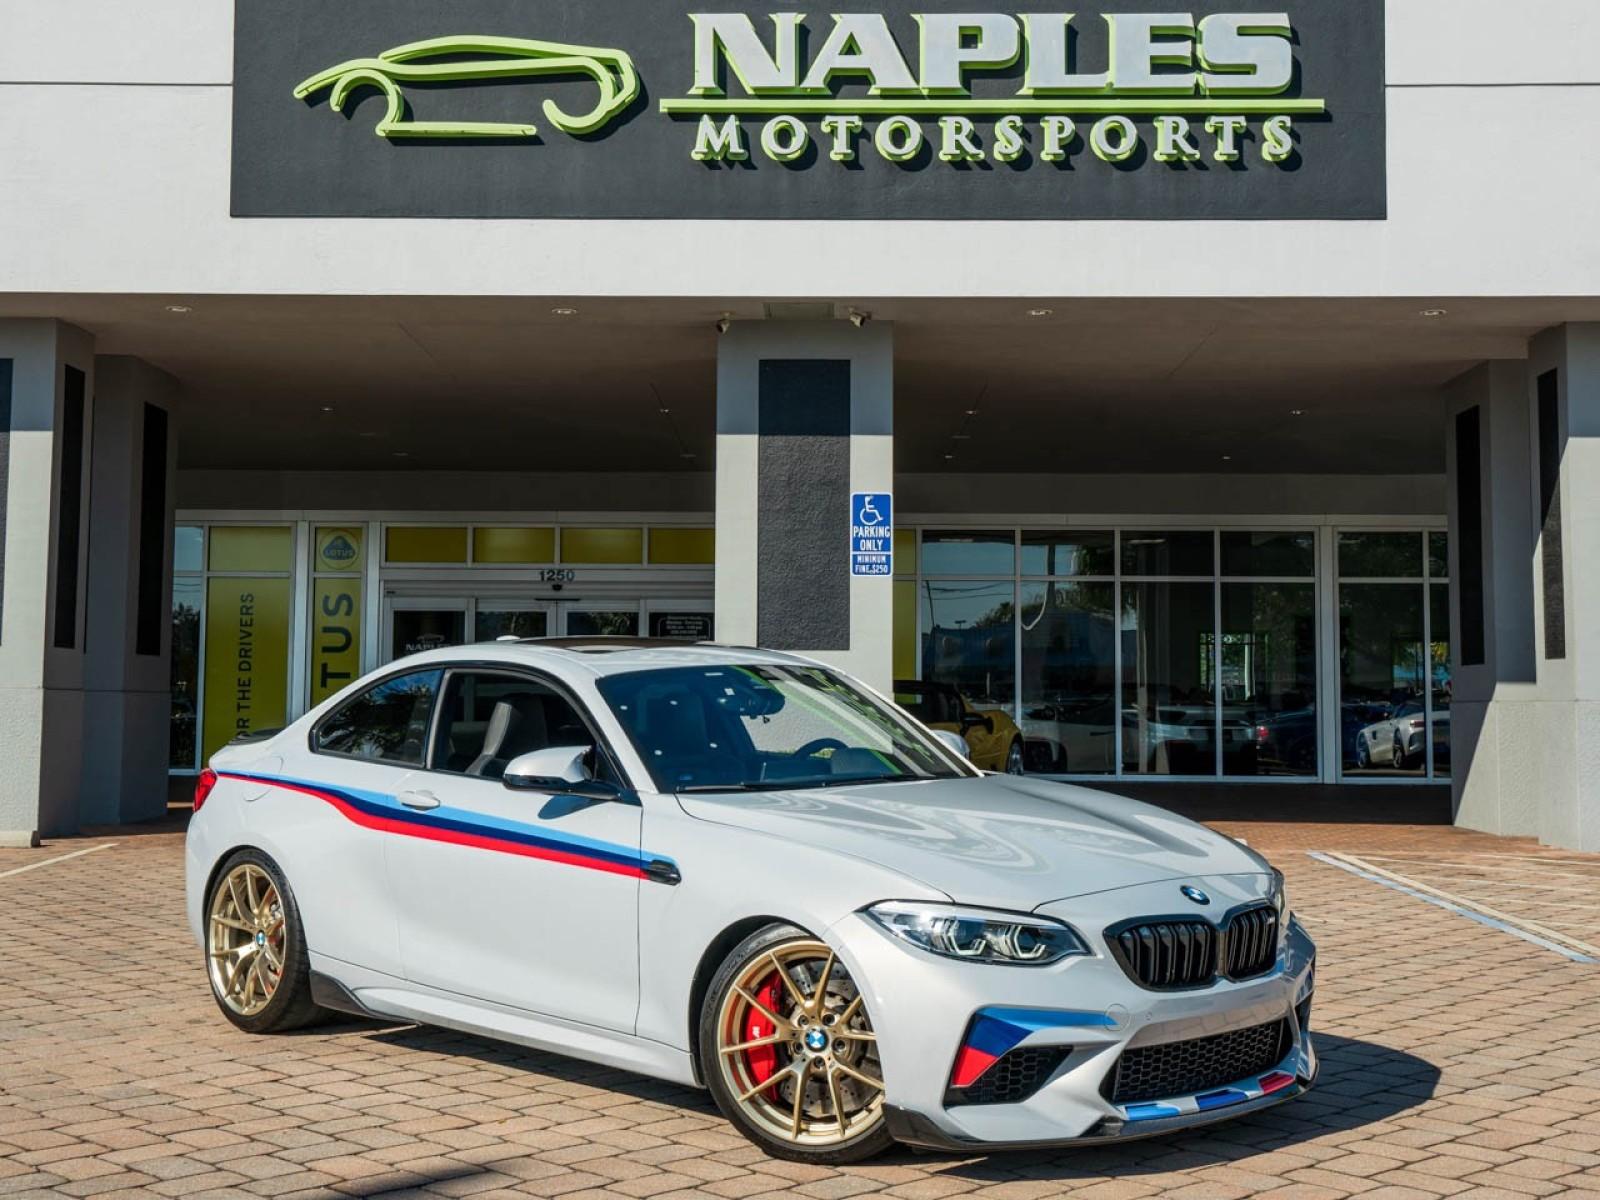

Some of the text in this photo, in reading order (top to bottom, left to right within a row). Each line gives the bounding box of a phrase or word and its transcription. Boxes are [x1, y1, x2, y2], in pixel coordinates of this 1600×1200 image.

[688, 12, 1294, 95] NAPLES
[691, 114, 1293, 162] MOTORSPORTS
[853, 526, 890, 538] PARKING
[860, 540, 883, 551] ONLY
[539, 569, 576, 581] 1250
[238, 592, 254, 672] DRIVERS
[320, 593, 353, 688] TUS
[236, 677, 251, 713] THE
